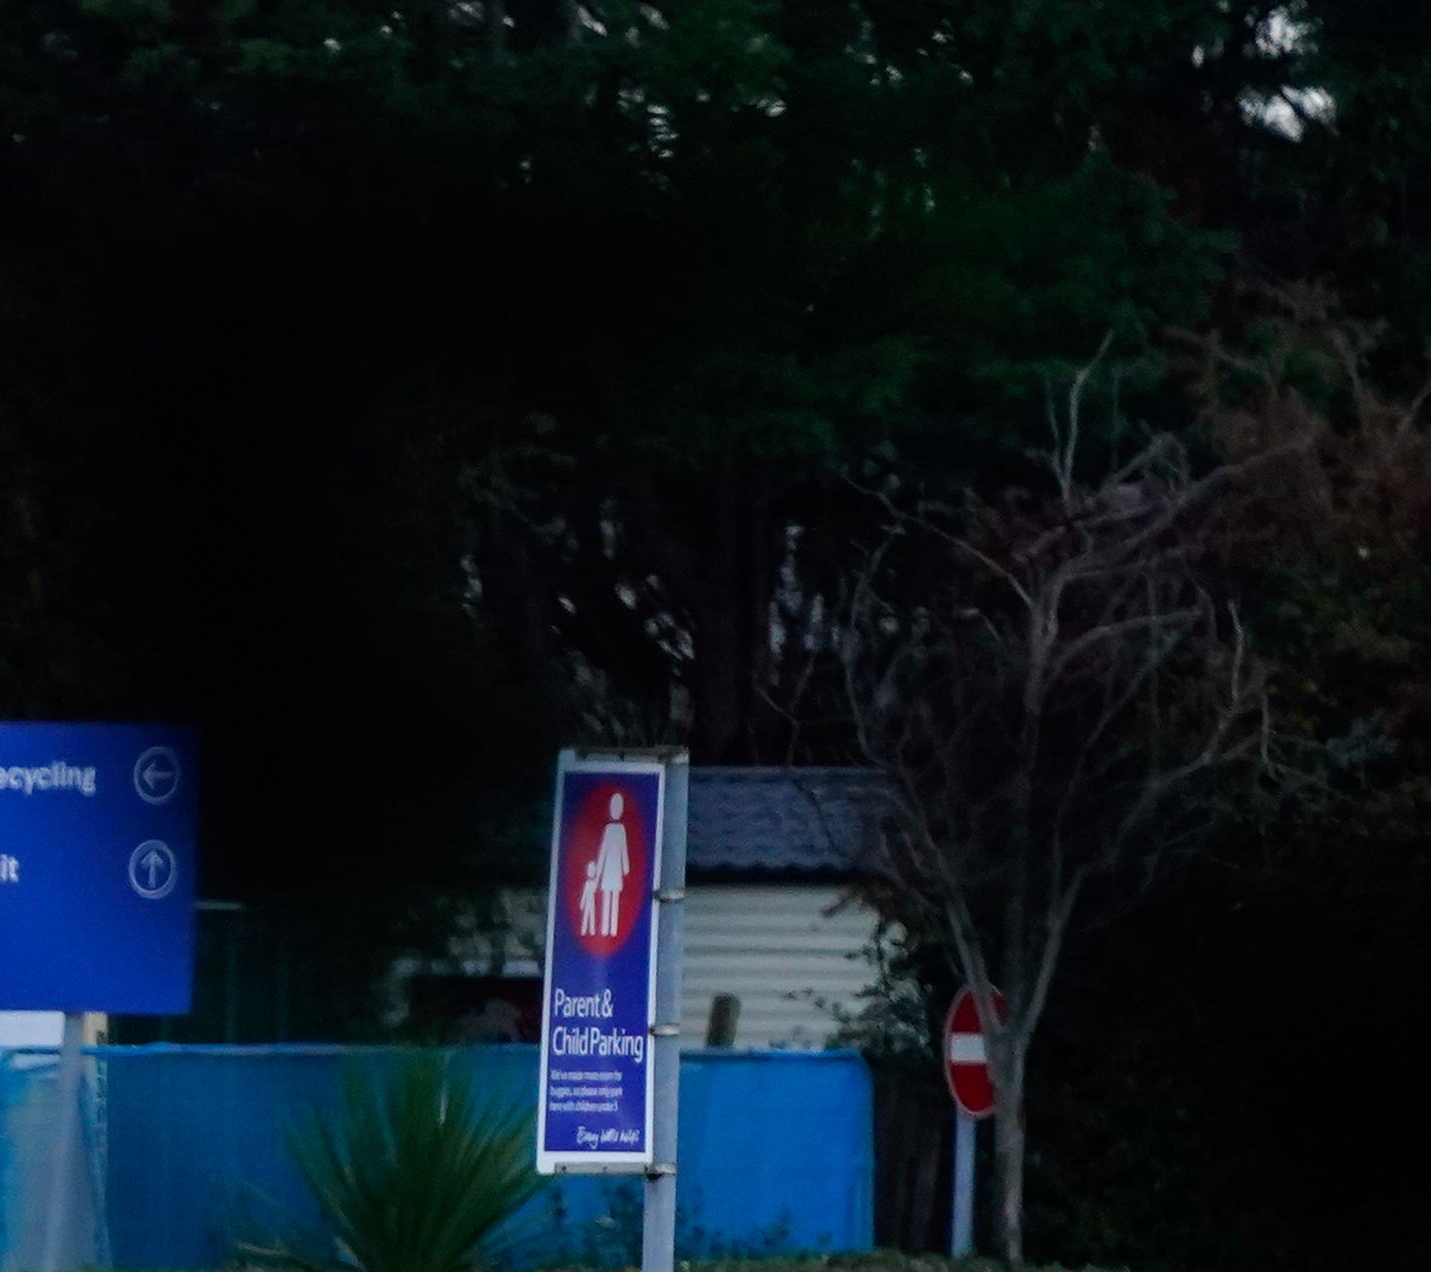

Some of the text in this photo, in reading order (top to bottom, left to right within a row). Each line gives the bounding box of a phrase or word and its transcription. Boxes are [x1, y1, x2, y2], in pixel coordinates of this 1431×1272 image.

[554, 988, 614, 1018] Parent &
[553, 1026, 644, 1063] Child Parking
